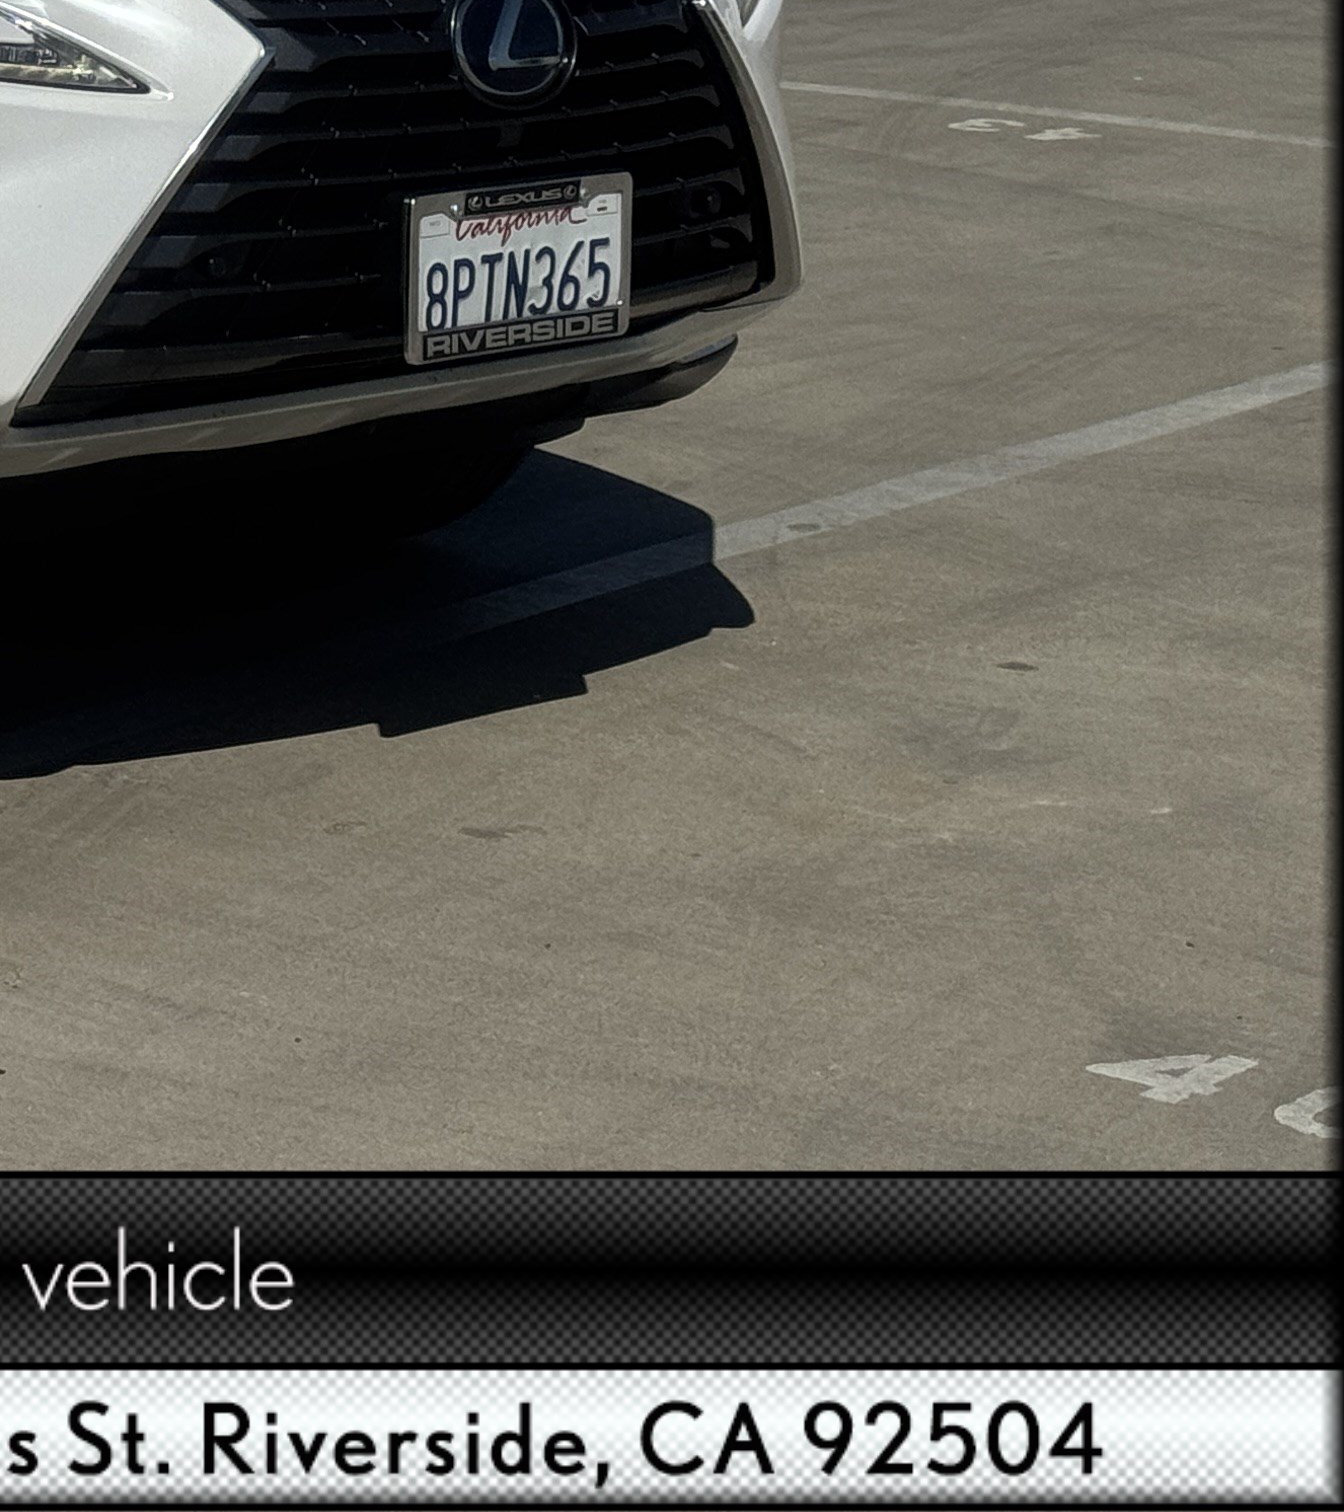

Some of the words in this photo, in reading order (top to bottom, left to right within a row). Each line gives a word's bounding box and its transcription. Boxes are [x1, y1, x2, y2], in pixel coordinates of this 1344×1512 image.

[486, 188, 562, 206] LEXUS
[455, 206, 587, 246] California
[427, 237, 610, 332] 8PTN365
[427, 313, 613, 357] RIVERSIDE
